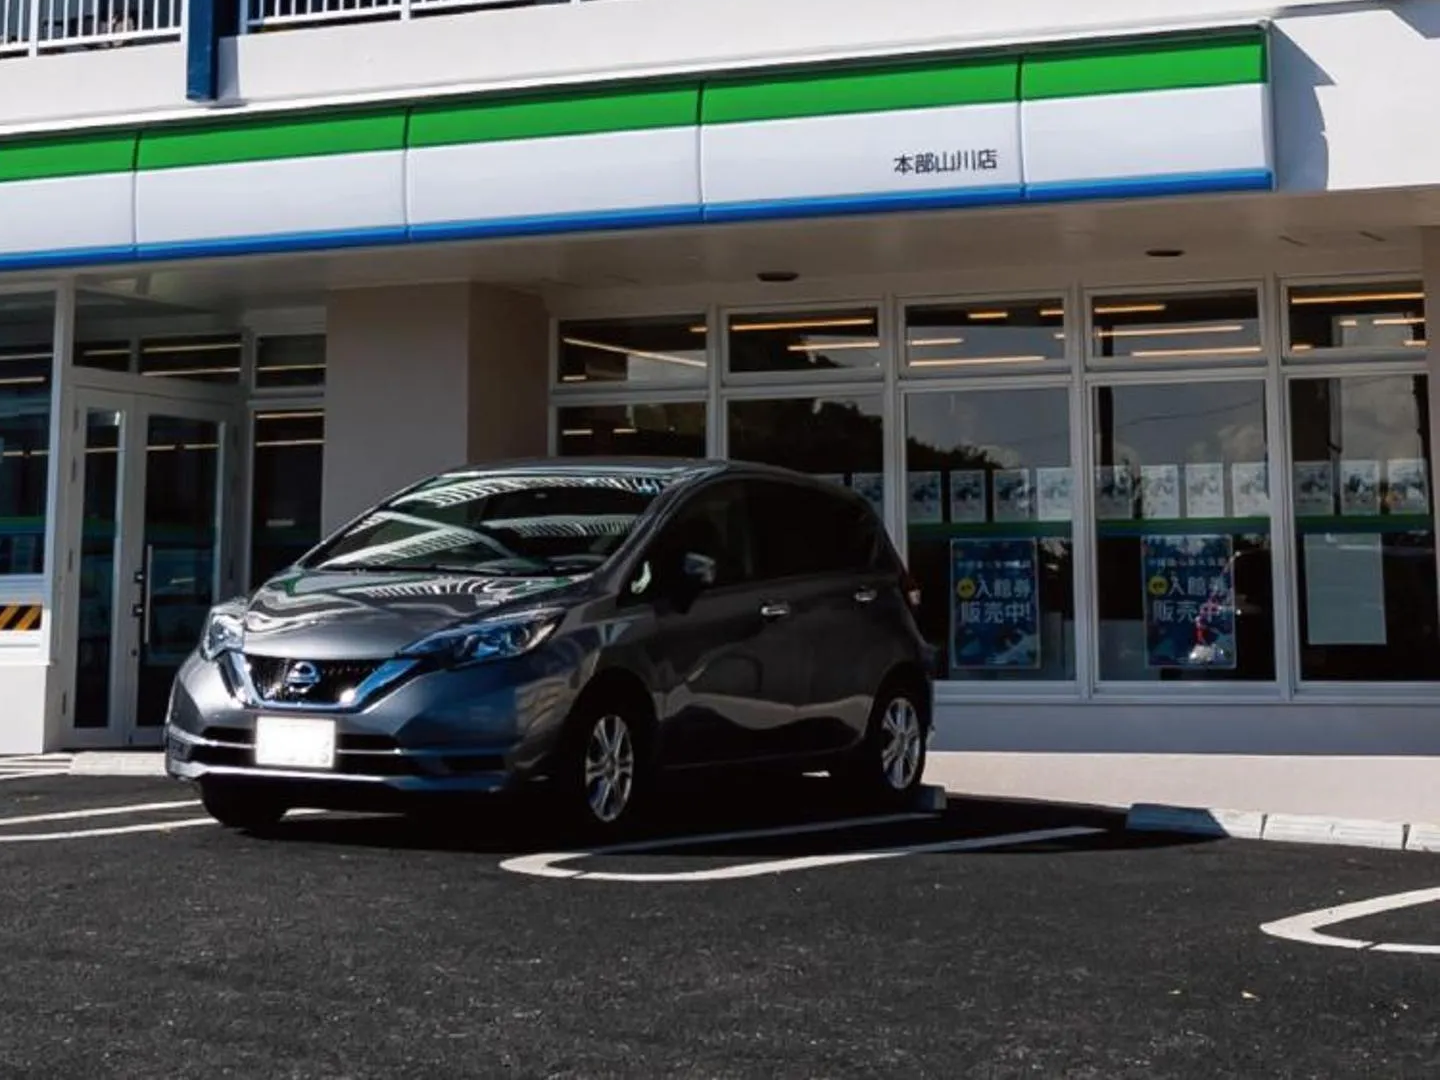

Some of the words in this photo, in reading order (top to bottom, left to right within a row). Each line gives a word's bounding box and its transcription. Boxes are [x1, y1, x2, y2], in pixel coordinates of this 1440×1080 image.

[894, 149, 998, 173] 本部山川店
